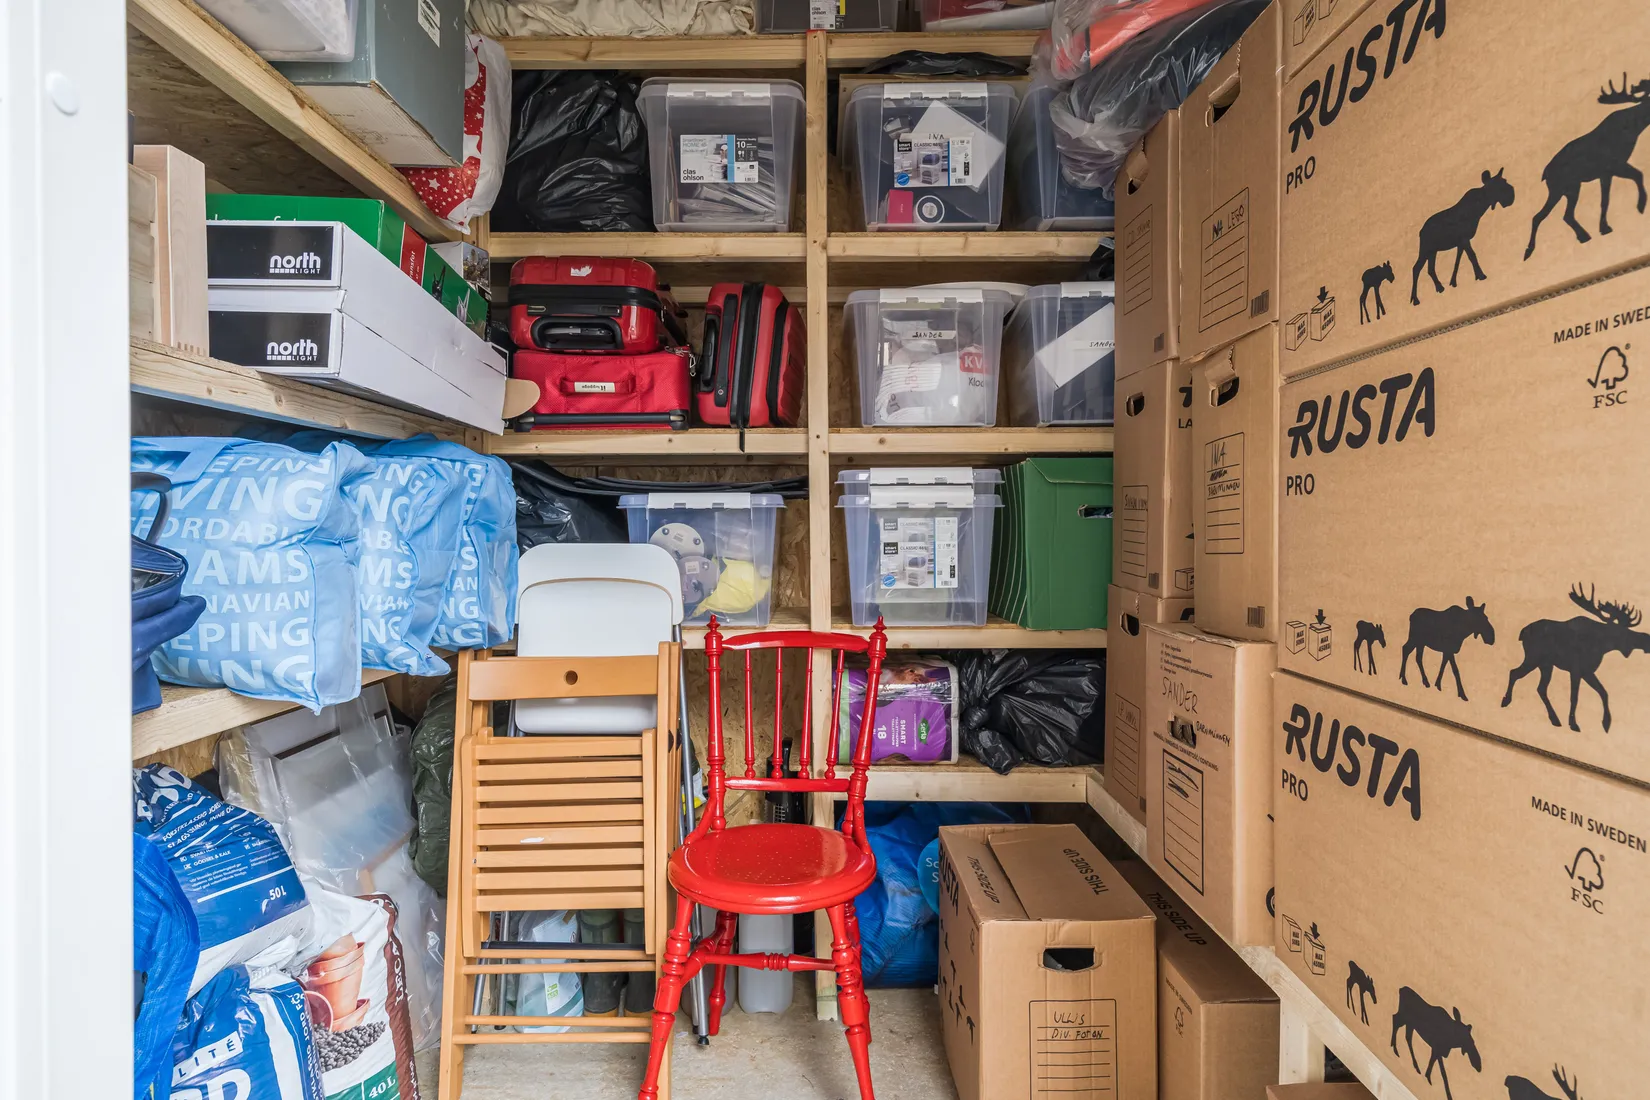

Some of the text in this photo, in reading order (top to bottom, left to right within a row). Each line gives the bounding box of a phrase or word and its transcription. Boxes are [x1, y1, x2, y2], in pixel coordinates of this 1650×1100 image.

[1288, 0, 1447, 154] RUSTA
[736, 141, 746, 149] 10
[1286, 156, 1316, 195] PRO
[269, 252, 321, 269] north
[266, 339, 318, 356] north
[1553, 322, 1592, 344] MADE
[1595, 318, 1609, 333] IN
[1287, 367, 1436, 459] RUSTA
[1593, 390, 1628, 409] FSC
[1286, 473, 1315, 496] PRO
[1162, 676, 1199, 714] SANDER
[877, 725, 887, 740] 18
[1282, 703, 1422, 822] RUSTA
[1281, 768, 1308, 801] PRO
[1531, 796, 1647, 853] MADE IN SWEDEN
[1063, 848, 1109, 896] THIS SIDE UP
[1570, 886, 1604, 915] FSC
[1147, 891, 1208, 946] THIS SIDE UP
